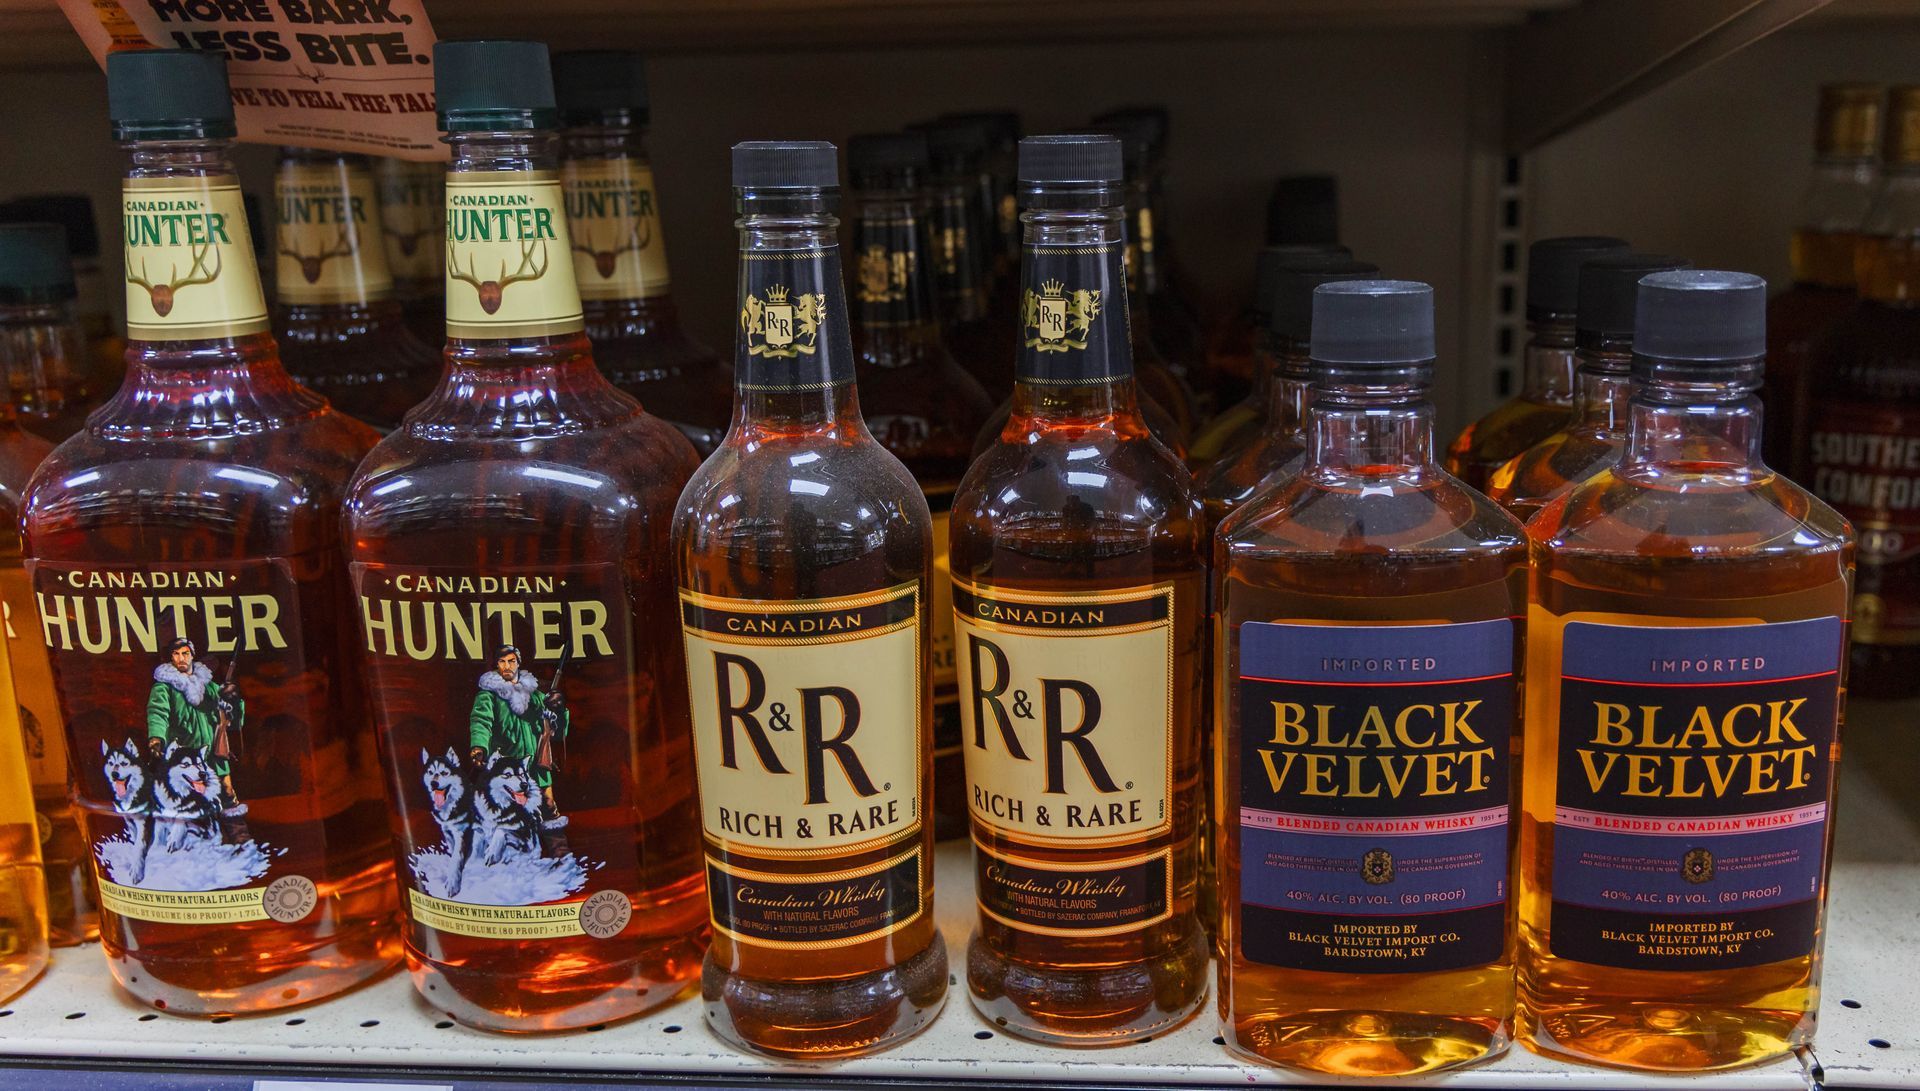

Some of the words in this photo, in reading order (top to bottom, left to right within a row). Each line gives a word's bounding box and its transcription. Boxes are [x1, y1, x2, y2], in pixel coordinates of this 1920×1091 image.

[149, 0, 275, 22] MORE
[296, 32, 430, 66] BITE.
[232, 87, 260, 106] VE
[257, 88, 290, 107] TO
[288, 89, 346, 111] TELL
[343, 92, 392, 114] THE
[390, 93, 436, 113] TAL
[126, 200, 198, 212] CANADIAN
[279, 196, 367, 224] UNTER
[453, 195, 528, 206] CANADIAN
[565, 189, 654, 219] UNTER
[124, 212, 232, 247] UNTER
[68, 570, 225, 588] CANADIAN
[396, 574, 554, 593] CANADIAN
[37, 591, 288, 654] HUNTER
[726, 613, 862, 633] CANADIAN
[978, 603, 1104, 624] CANADIAN
[361, 595, 615, 661] HUNTER
[1322, 657, 1436, 671] IMPORTED
[1651, 657, 1766, 672] IMPORTED
[1268, 700, 1485, 748] BLACK
[1589, 698, 1808, 749] BLACK
[1257, 747, 1495, 799] VELVET
[1576, 744, 1816, 798] VELVET
[974, 784, 1024, 822] RICH
[1036, 805, 1052, 827] &
[1066, 799, 1142, 828] RARE
[719, 806, 783, 839] RICH
[796, 818, 814, 839] &
[828, 799, 900, 837] RARE
[1277, 816, 1340, 831] BLENDED
[1346, 821, 1419, 832] CANADIAN
[1424, 816, 1475, 830] WHISKY
[1594, 817, 1662, 831] BLENDED
[1668, 820, 1741, 832] CANADIAN
[1746, 814, 1794, 828] WHISKY
[267, 878, 312, 902] CANADIAN
[986, 865, 1053, 894] Canadian
[1056, 876, 1127, 898] Whisky
[127, 891, 154, 903] WHISKY
[156, 894, 177, 904] WITH
[178, 895, 217, 904] NATURAL
[219, 892, 259, 904] FLAVORS
[736, 884, 816, 908] Canadian
[818, 879, 886, 906] Whisky
[1007, 891, 1024, 902] WITH
[1025, 894, 1059, 908] NATURAL
[1061, 899, 1097, 909] FLAVORS
[1286, 890, 1313, 902] 40%
[1318, 894, 1345, 904] ALC.
[1349, 896, 1363, 904] BY
[1366, 895, 1393, 905] VOL.
[1401, 893, 1421, 905] (80
[1424, 888, 1466, 903] PROOF)
[1601, 890, 1631, 901] 40%
[1635, 893, 1661, 903] ALC.
[1667, 895, 1681, 903] BY
[1685, 895, 1711, 904] VOL.
[1719, 892, 1738, 904] (80
[1742, 885, 1782, 900] PROOF)
[272, 900, 312, 919] HUNTER
[441, 904, 470, 917] WHISKY
[471, 909, 492, 918] WITH
[494, 909, 534, 919] NATURAL
[536, 907, 576, 918] FLAVORS
[584, 893, 628, 917] CANADIAN
[763, 910, 783, 921] WITH
[784, 910, 820, 921] NATURAL
[823, 906, 859, 920] FLAVORS
[1020, 907, 1046, 919] BOTTLED
[1057, 912, 1086, 920] SAZERAC
[1087, 910, 1118, 921] COMPANY,
[466, 924, 497, 934] VOLUME
[499, 926, 513, 935] (80
[516, 926, 548, 935] PROOF)
[555, 923, 578, 933] 1.75L
[587, 916, 627, 935] HUNTER
[779, 925, 808, 934] BOTTLED
[819, 922, 849, 933] SAZERAC
[1334, 924, 1400, 935] IMPORTED
[1404, 924, 1418, 934] BY
[1650, 922, 1717, 933] IMPORTED
[1720, 922, 1734, 932] BY
[1289, 932, 1330, 944] BLACK
[1334, 936, 1381, 946] VELVET
[1386, 935, 1438, 946] IMPORT
[1440, 933, 1461, 942] CO.
[1602, 930, 1645, 943] BLACK
[1650, 934, 1698, 945] VELVET
[1702, 930, 1751, 944] IMPORT
[1754, 928, 1774, 939] CO.
[1324, 947, 1407, 960] BARDSTOWN,
[1411, 947, 1427, 957] KY
[1638, 945, 1722, 956] BARDSTOWN,
[1727, 943, 1742, 953] KY
